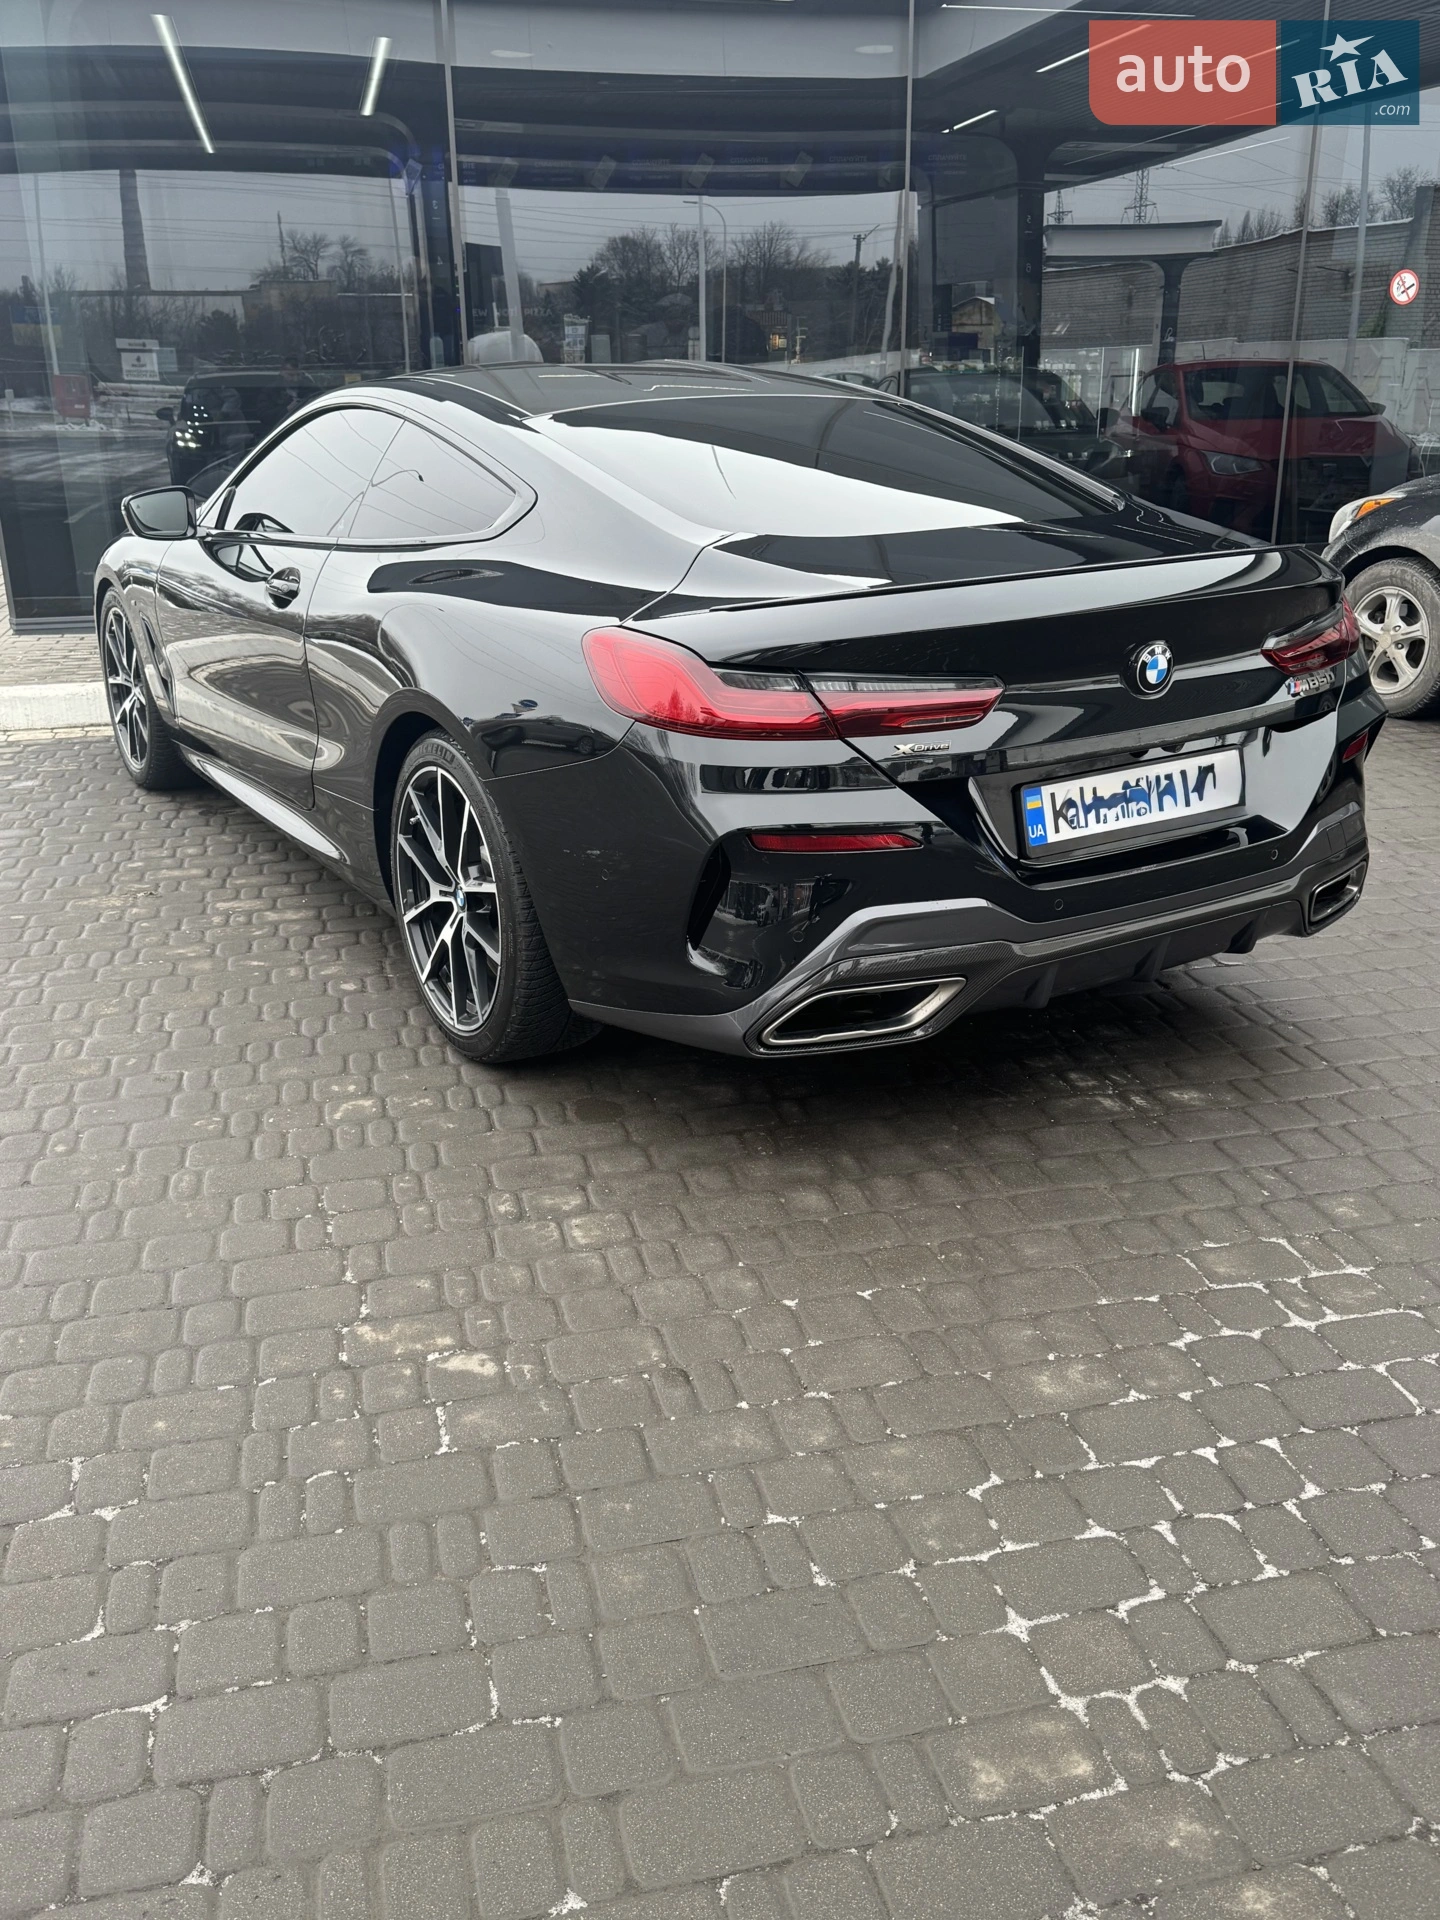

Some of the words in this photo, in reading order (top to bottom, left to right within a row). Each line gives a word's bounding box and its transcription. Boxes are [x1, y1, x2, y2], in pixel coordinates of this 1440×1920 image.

[524, 308, 554, 317] PIZZA
[1142, 646, 1172, 663] BMW
[1028, 823, 1046, 838] UA
